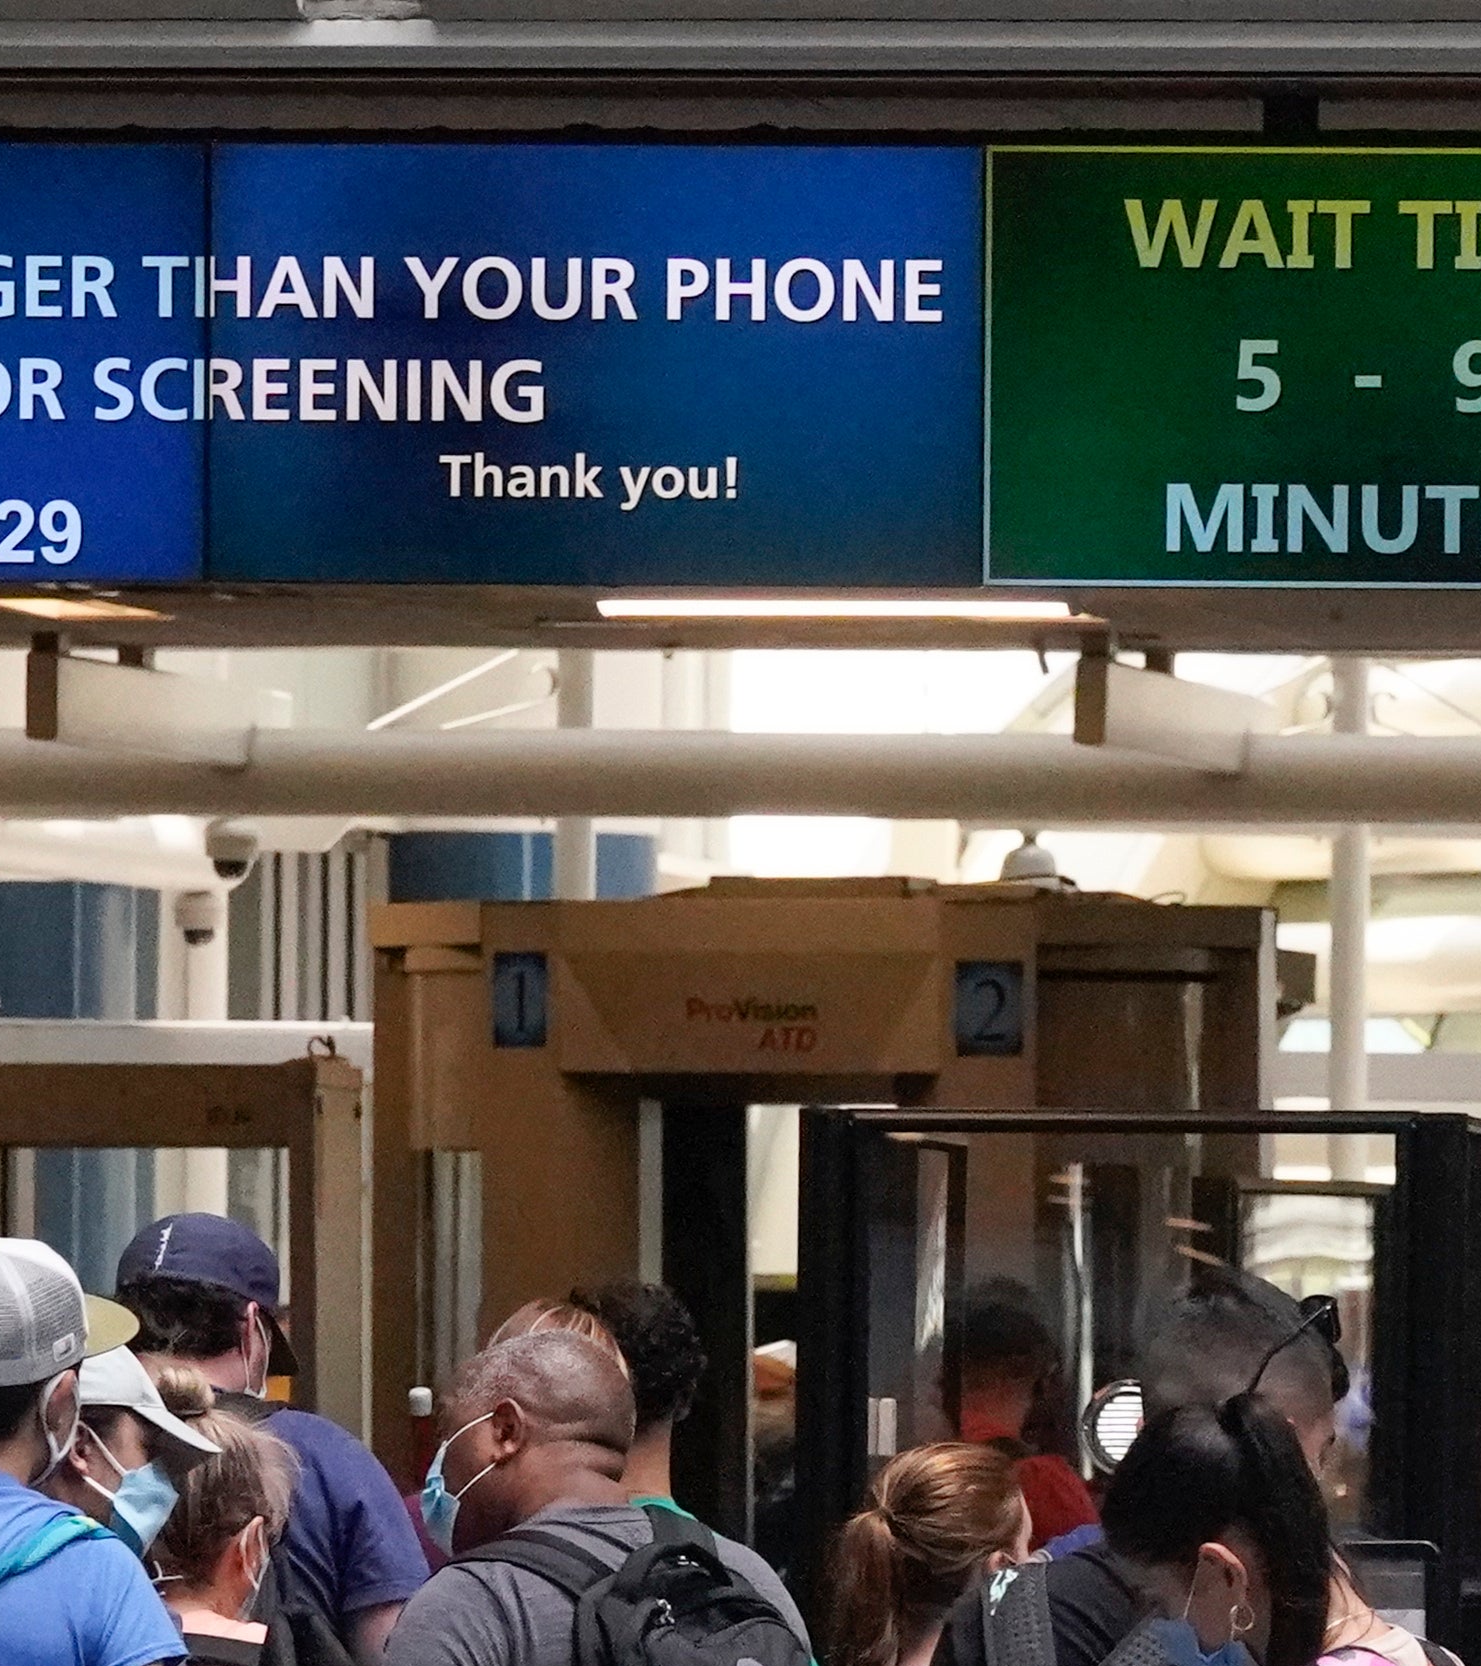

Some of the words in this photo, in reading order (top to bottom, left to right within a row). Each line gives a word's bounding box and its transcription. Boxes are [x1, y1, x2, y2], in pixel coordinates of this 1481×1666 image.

[1124, 199, 1370, 268] WAIT
[142, 256, 374, 318] THAN
[404, 257, 637, 320] YOUR
[667, 258, 942, 321] PHONE
[94, 358, 543, 422] SCREENING
[1237, 340, 1281, 411] 5
[1355, 376, 1381, 387] -
[440, 453, 603, 497] Thank
[620, 457, 737, 510] you!
[686, 1000, 817, 1024] ProVision
[759, 1026, 817, 1051] ATD
[973, 977, 1007, 1042] 2
